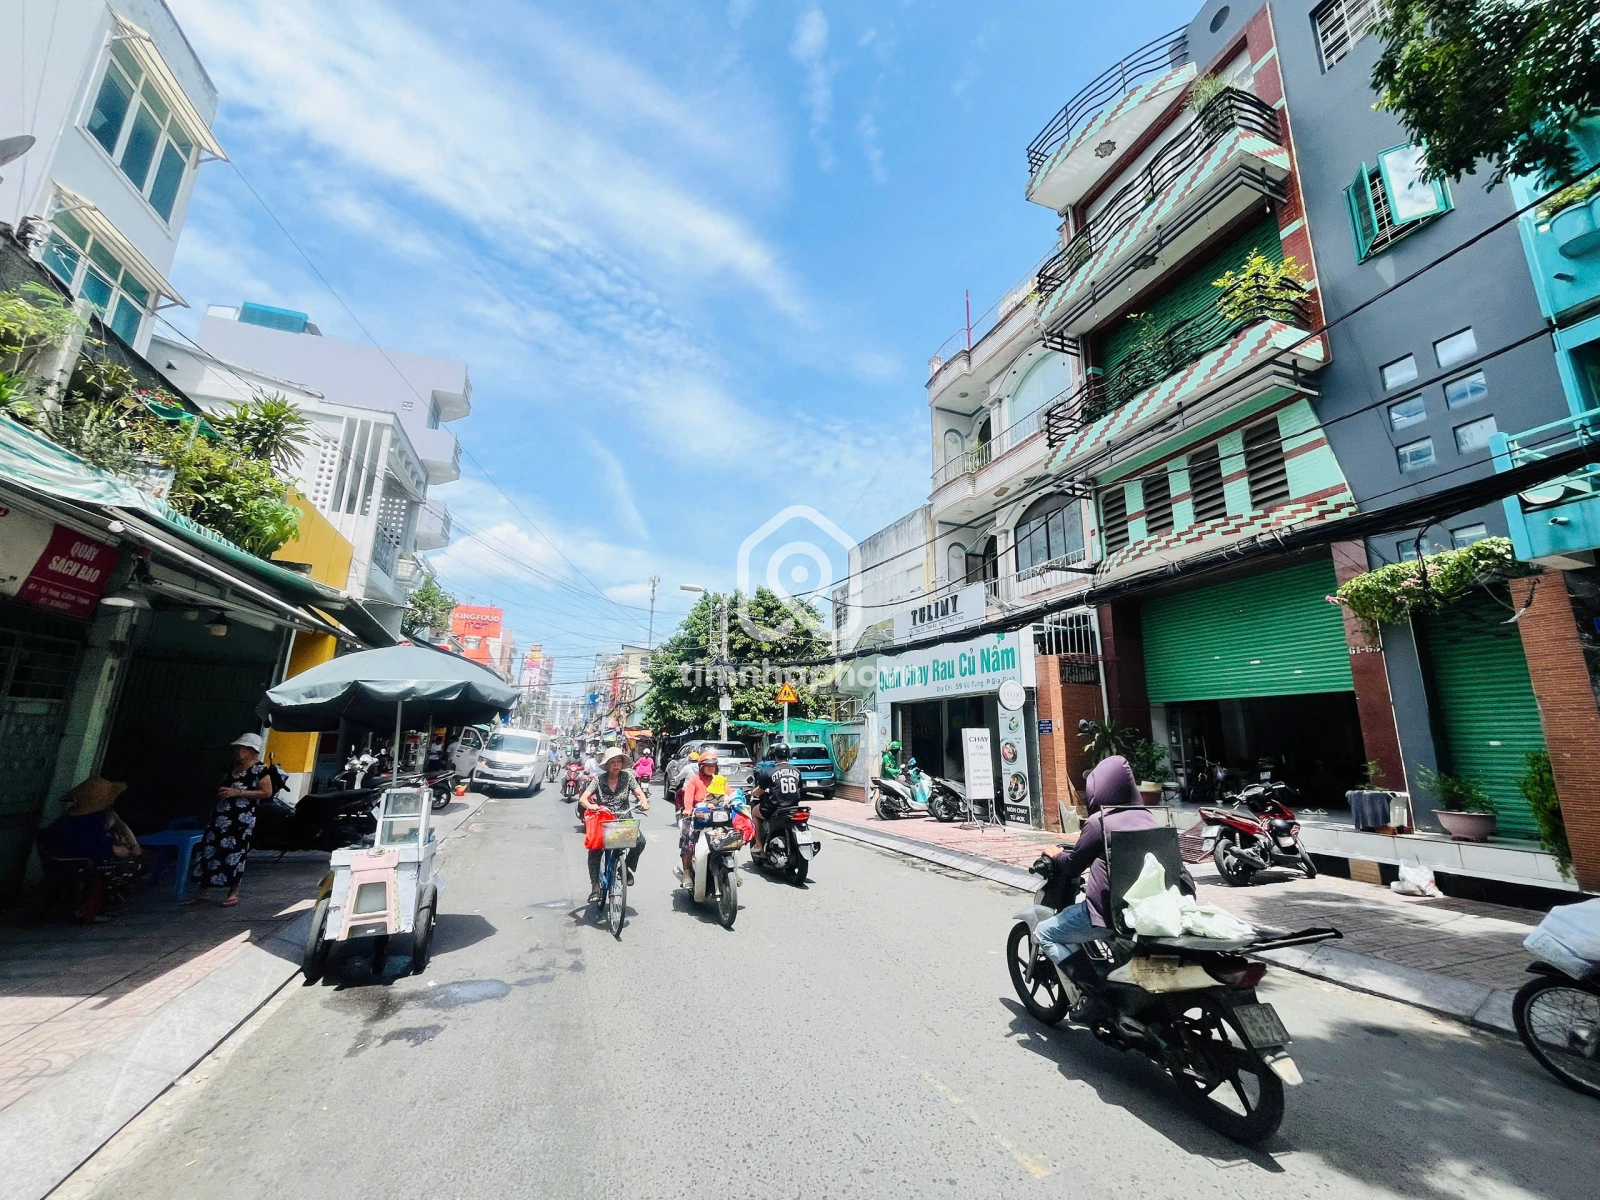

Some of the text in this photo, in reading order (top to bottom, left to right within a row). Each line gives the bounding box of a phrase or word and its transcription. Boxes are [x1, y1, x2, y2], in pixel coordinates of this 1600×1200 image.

[455, 613, 500, 623] KINGFOOD
[910, 594, 959, 627] TULIMY
[879, 666, 902, 693] Quán
[904, 664, 929, 687] Chay
[932, 657, 955, 682] Rau
[958, 648, 976, 678] Củ
[955, 681, 963, 690] 59
[780, 776, 797, 794] 66
